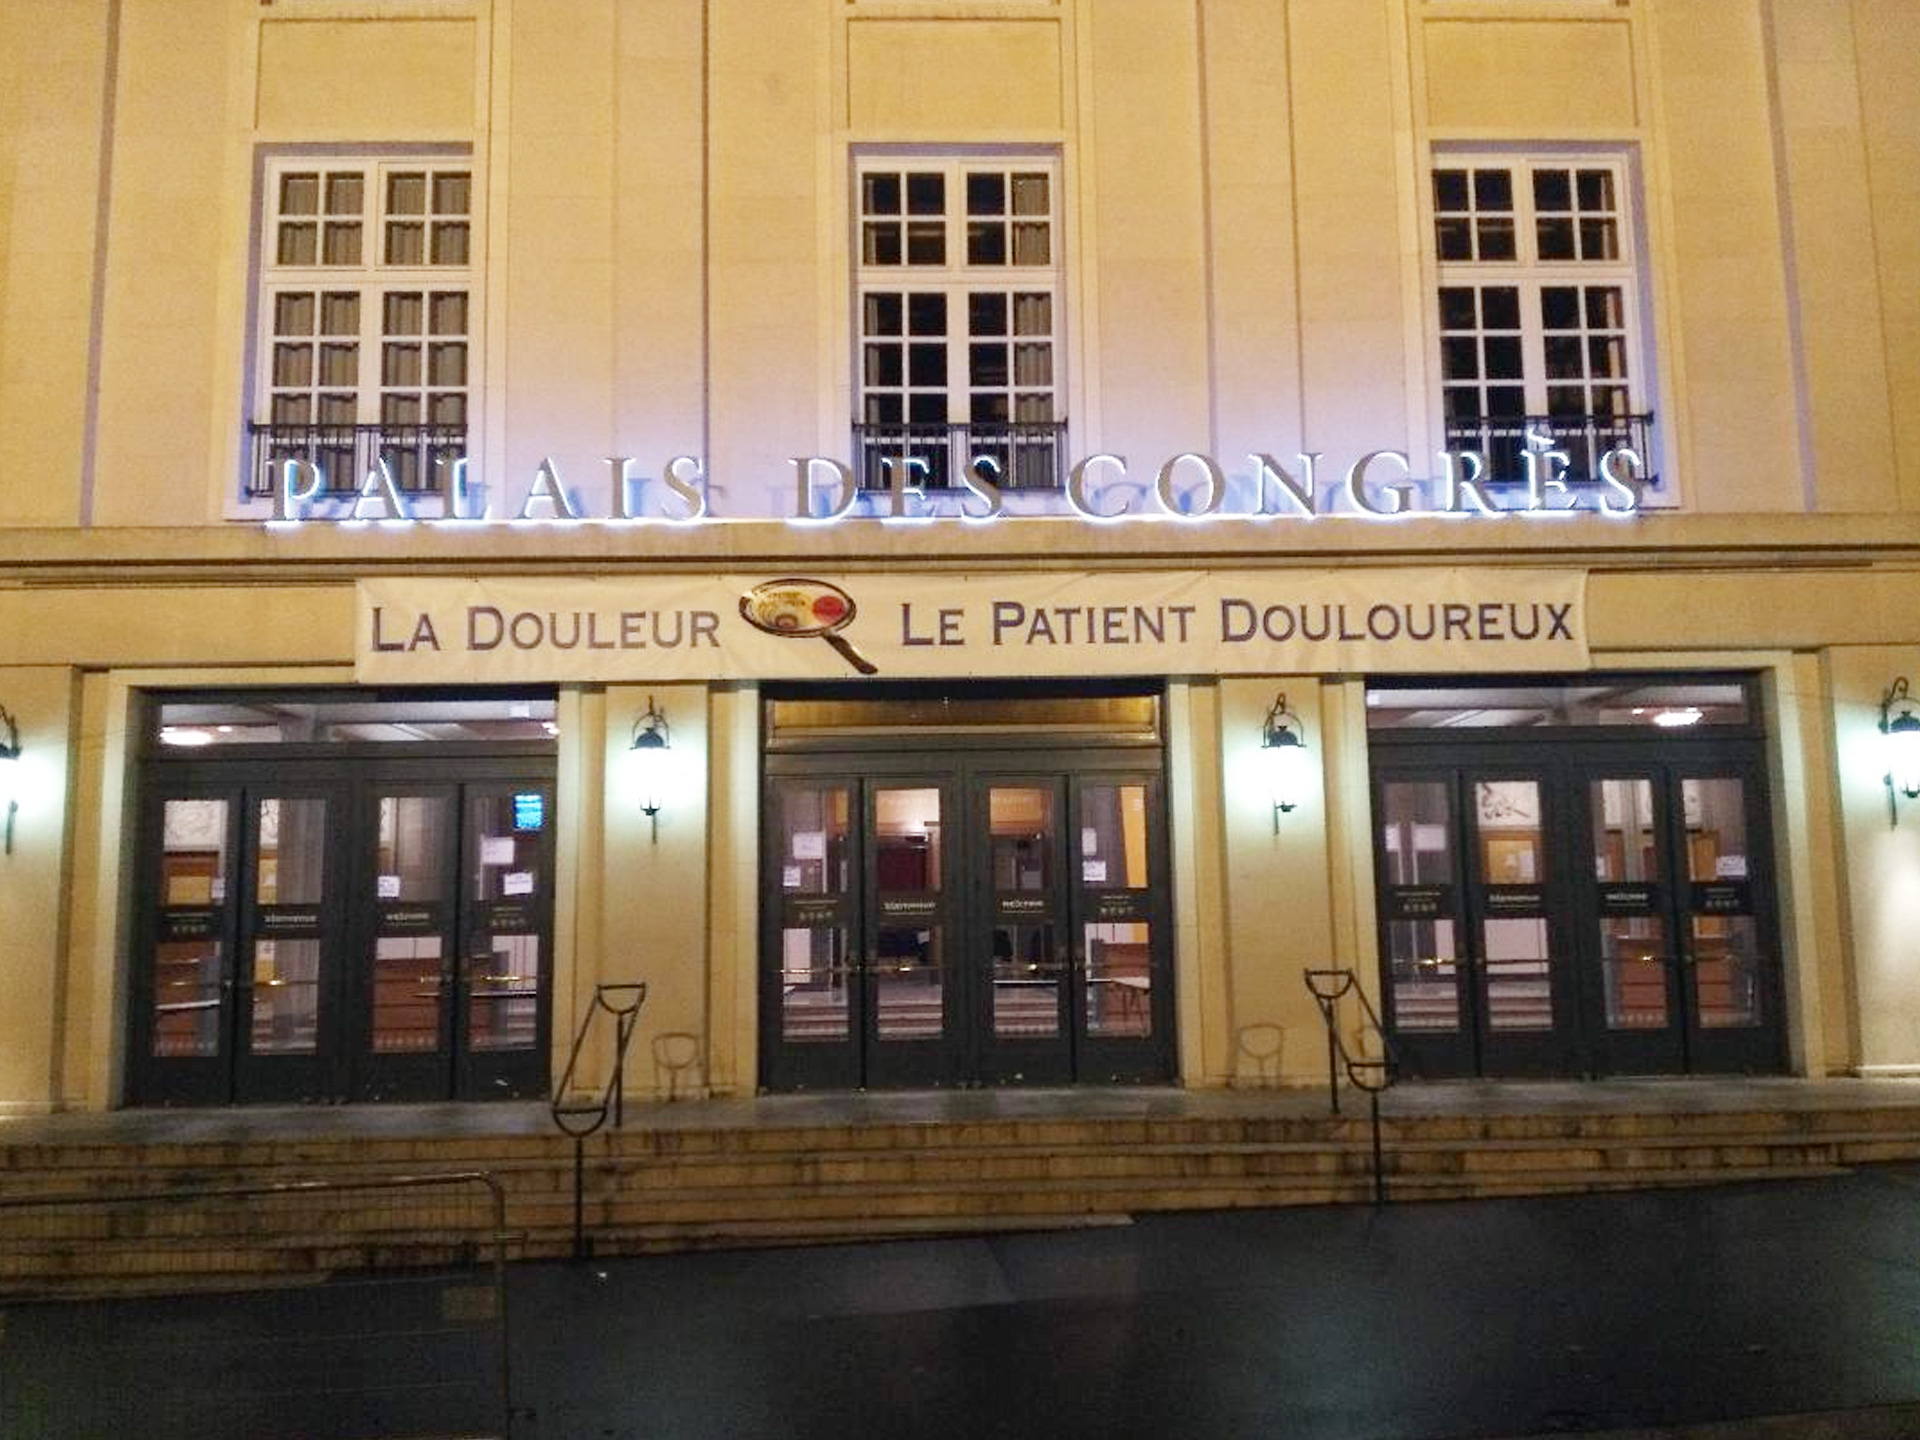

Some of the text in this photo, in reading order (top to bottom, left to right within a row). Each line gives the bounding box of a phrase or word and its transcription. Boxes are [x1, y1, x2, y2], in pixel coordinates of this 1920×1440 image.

[266, 426, 1645, 526] PALAIS DES CONGRÈS
[372, 608, 721, 652] LA DOULEUR
[902, 600, 1574, 645] LE PATIENT DOULOUREUX
